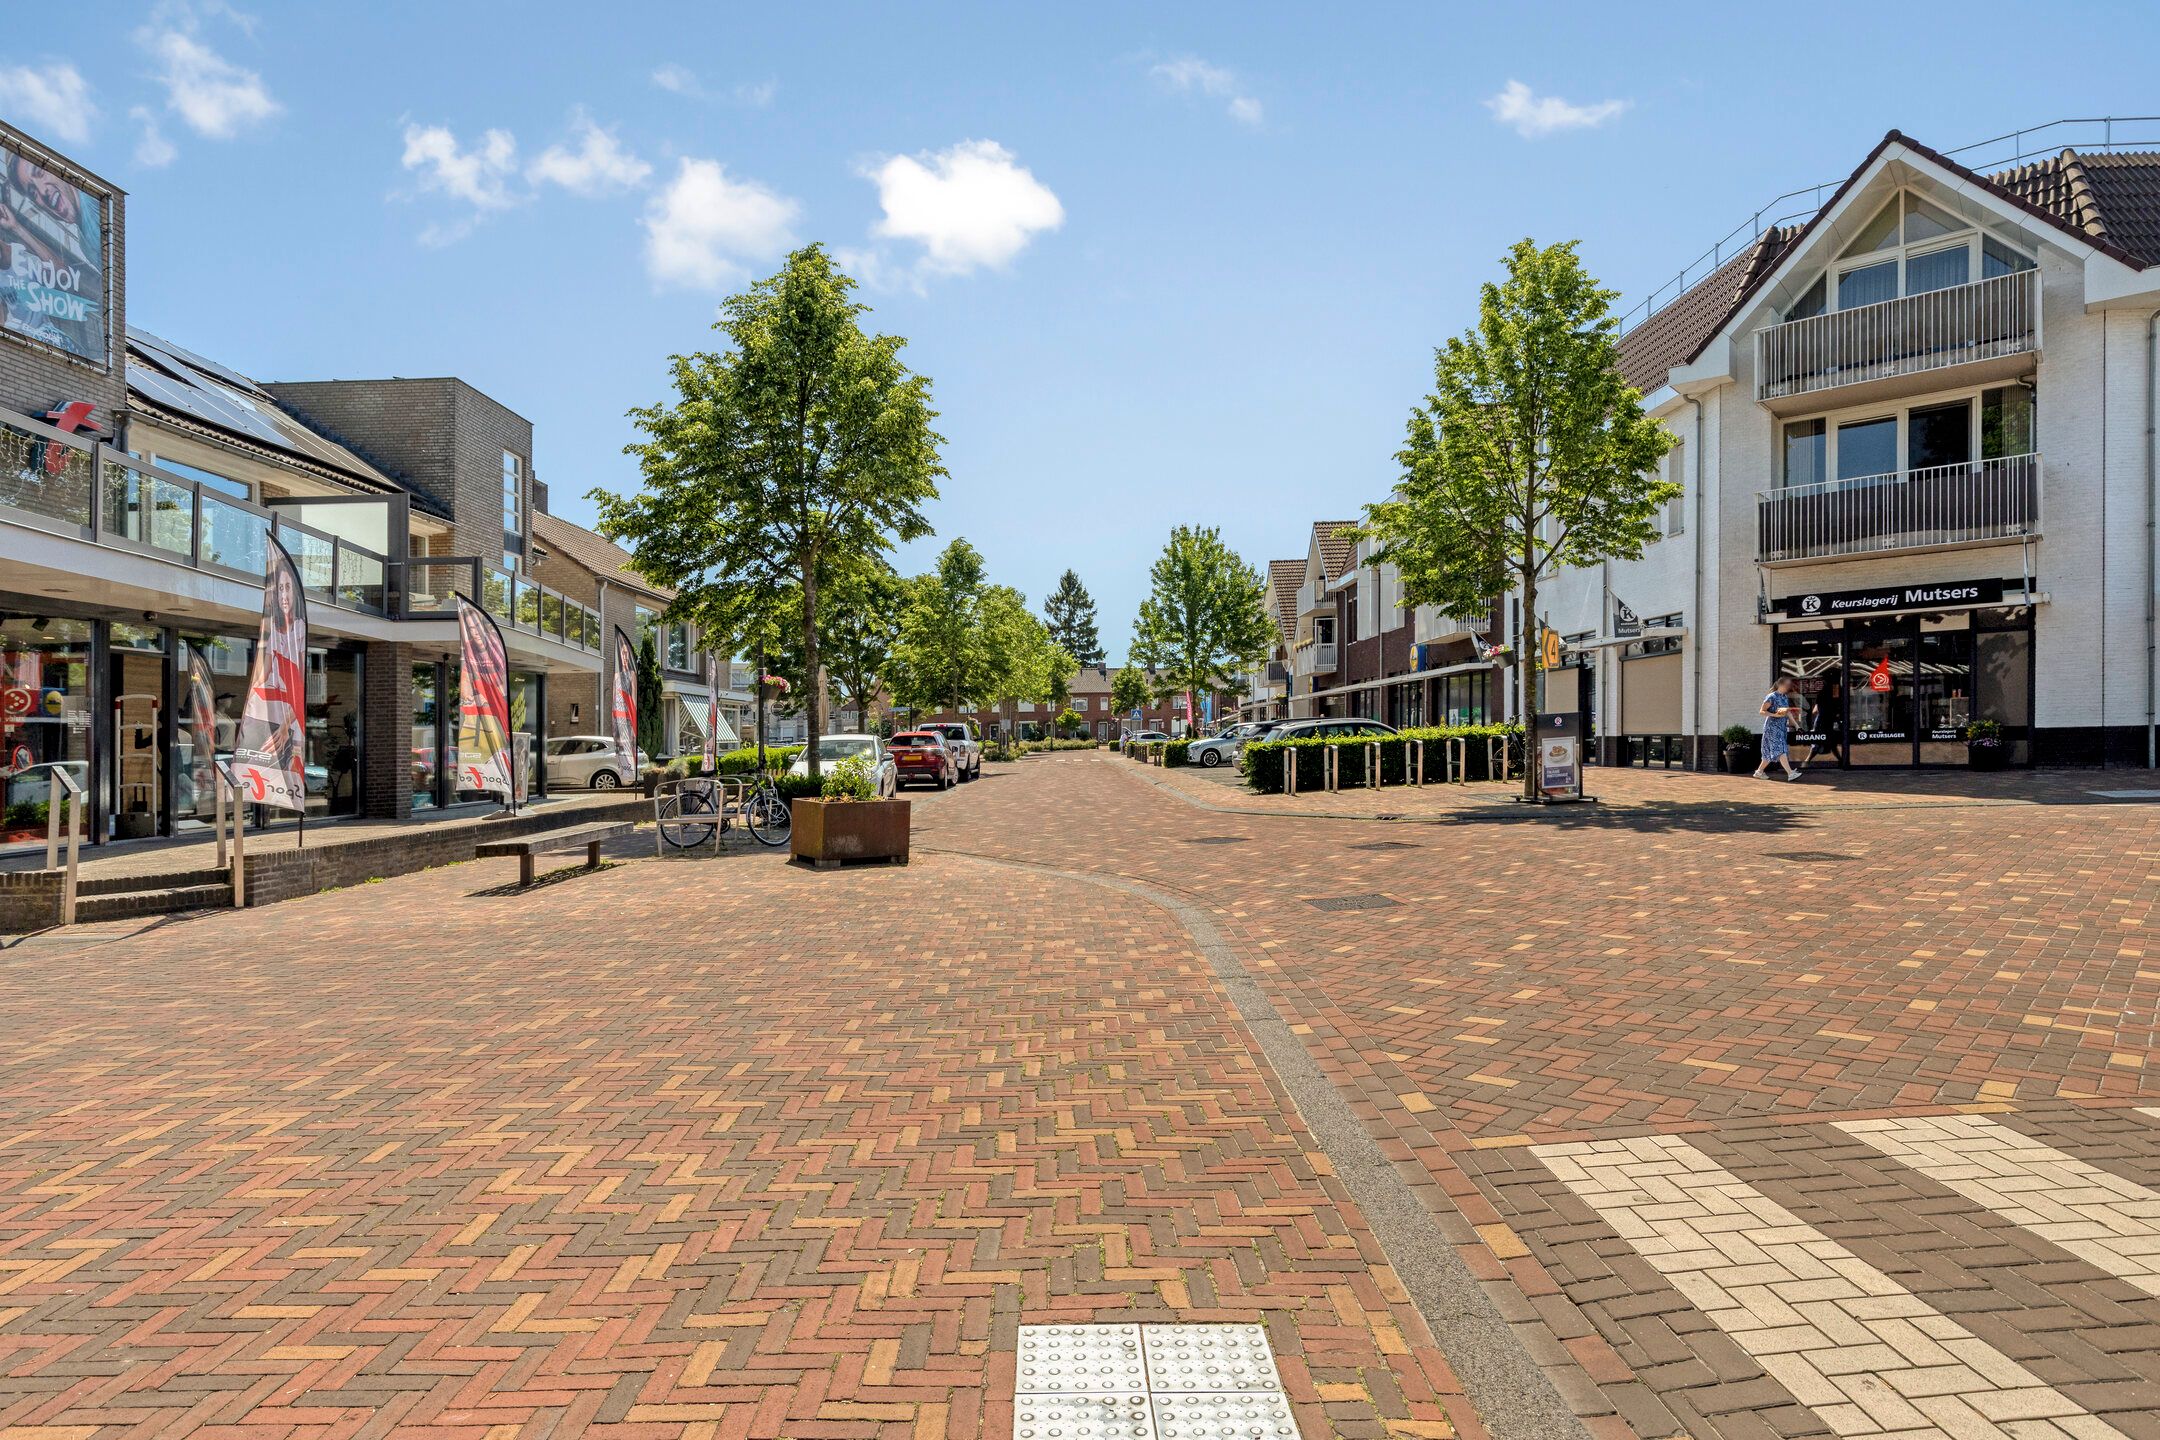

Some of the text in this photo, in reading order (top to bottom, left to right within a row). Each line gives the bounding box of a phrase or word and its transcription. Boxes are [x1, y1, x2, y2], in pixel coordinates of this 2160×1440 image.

[8, 275, 26, 290] THE
[9, 242, 81, 292] ENJOY
[26, 281, 87, 321] SHOW
[1831, 595, 1898, 609] Keurslagerij
[1905, 586, 1979, 603] Mutsers
